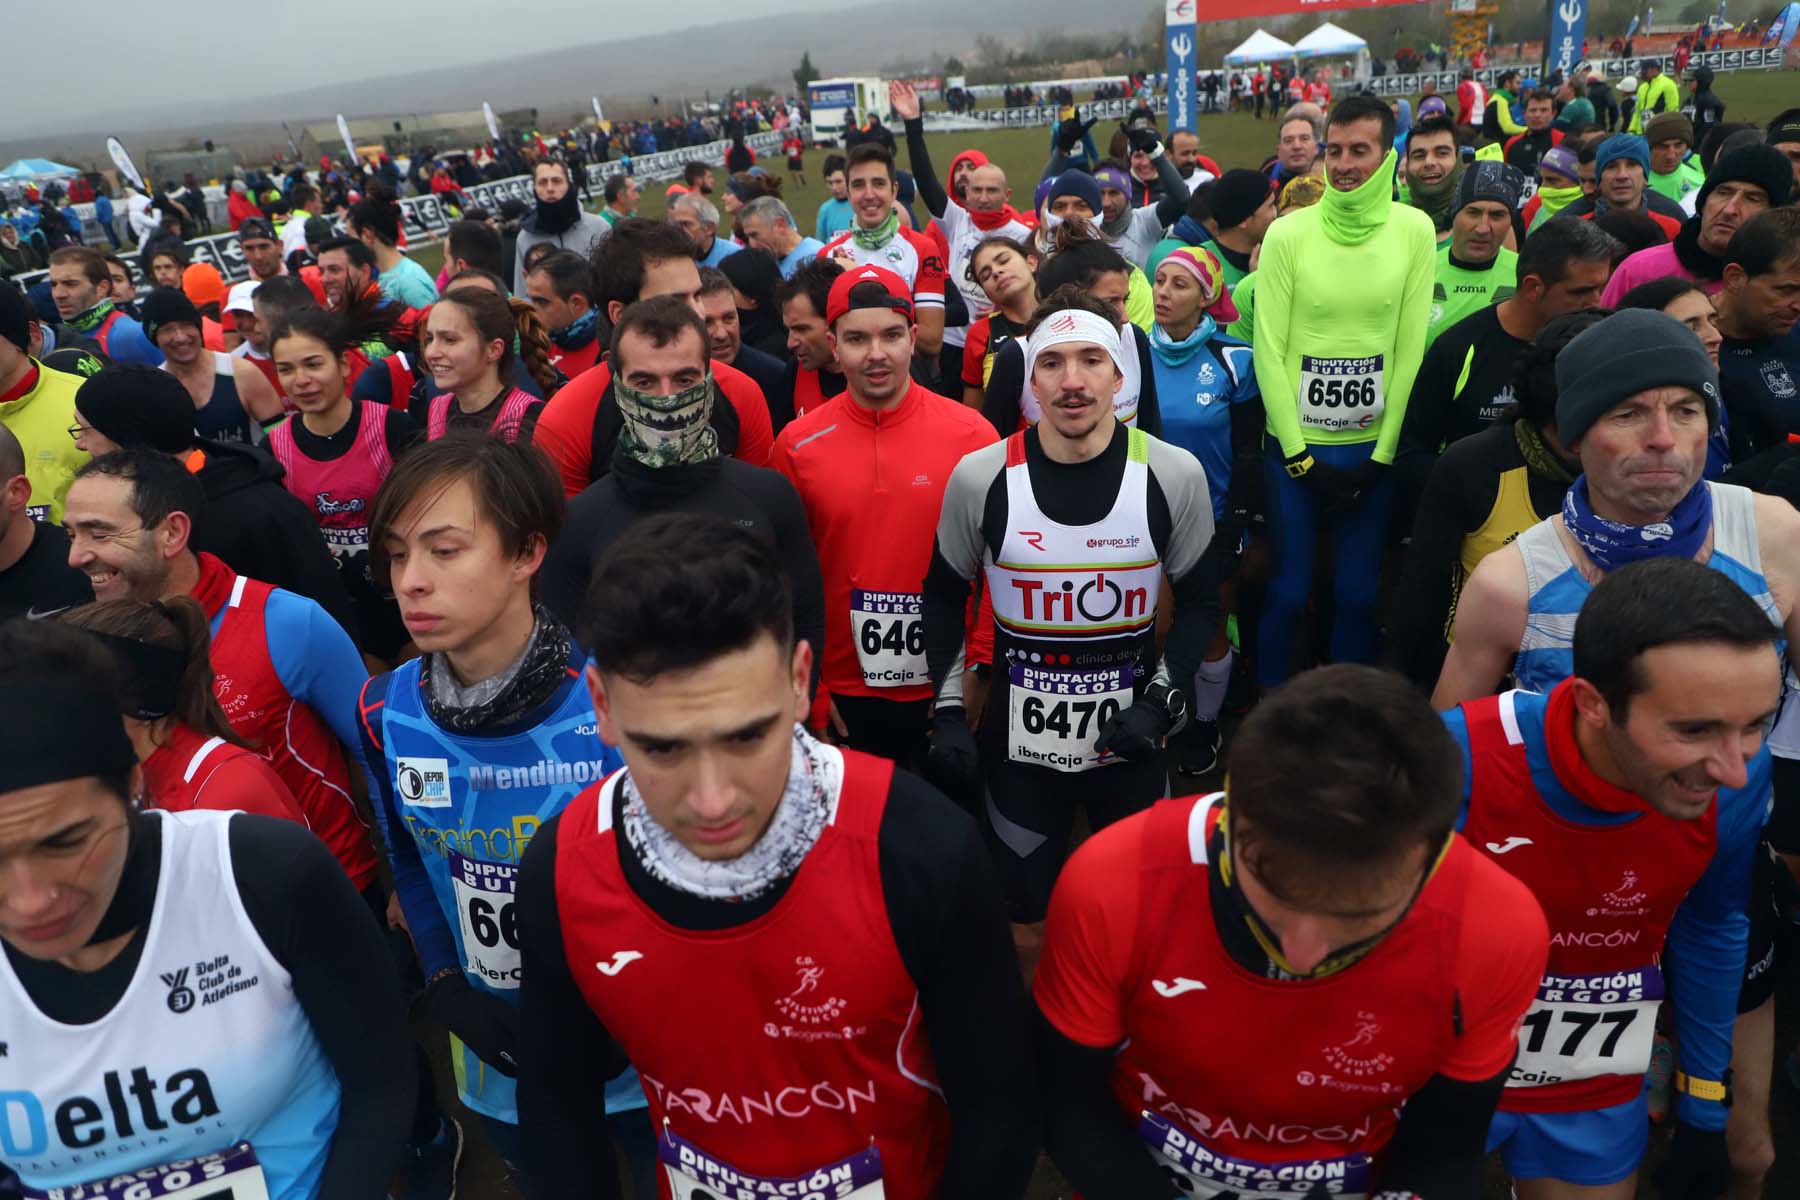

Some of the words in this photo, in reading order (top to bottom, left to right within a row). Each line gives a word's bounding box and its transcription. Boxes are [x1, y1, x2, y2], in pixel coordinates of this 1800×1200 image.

[1311, 358, 1376, 368] DIPUTACIÓN
[1311, 365, 1375, 375] BURGOS
[1308, 378, 1375, 408] 6566
[1303, 414, 1349, 428] iberCaja
[861, 618, 926, 656] 646
[1023, 667, 1120, 684] DIPUTACIÓN
[1023, 677, 1120, 694] BURGOS
[1022, 697, 1121, 740] 6470
[1018, 746, 1083, 768] iberCaja
[469, 759, 605, 792] Mendinox
[195, 954, 229, 976] Delta
[199, 971, 225, 991] Club
[227, 964, 242, 979] de
[202, 976, 259, 1006] Atletismo
[0, 1066, 221, 1158] Delta
[643, 1073, 877, 1125] TARANCÓN
[1138, 1072, 1371, 1144] TARANCÓN
[1162, 1142, 1345, 1195] BURGOS
[1166, 1127, 1346, 1183] DIPUTACIÓN
[679, 1145, 852, 1197] DIPUTACIÓN
